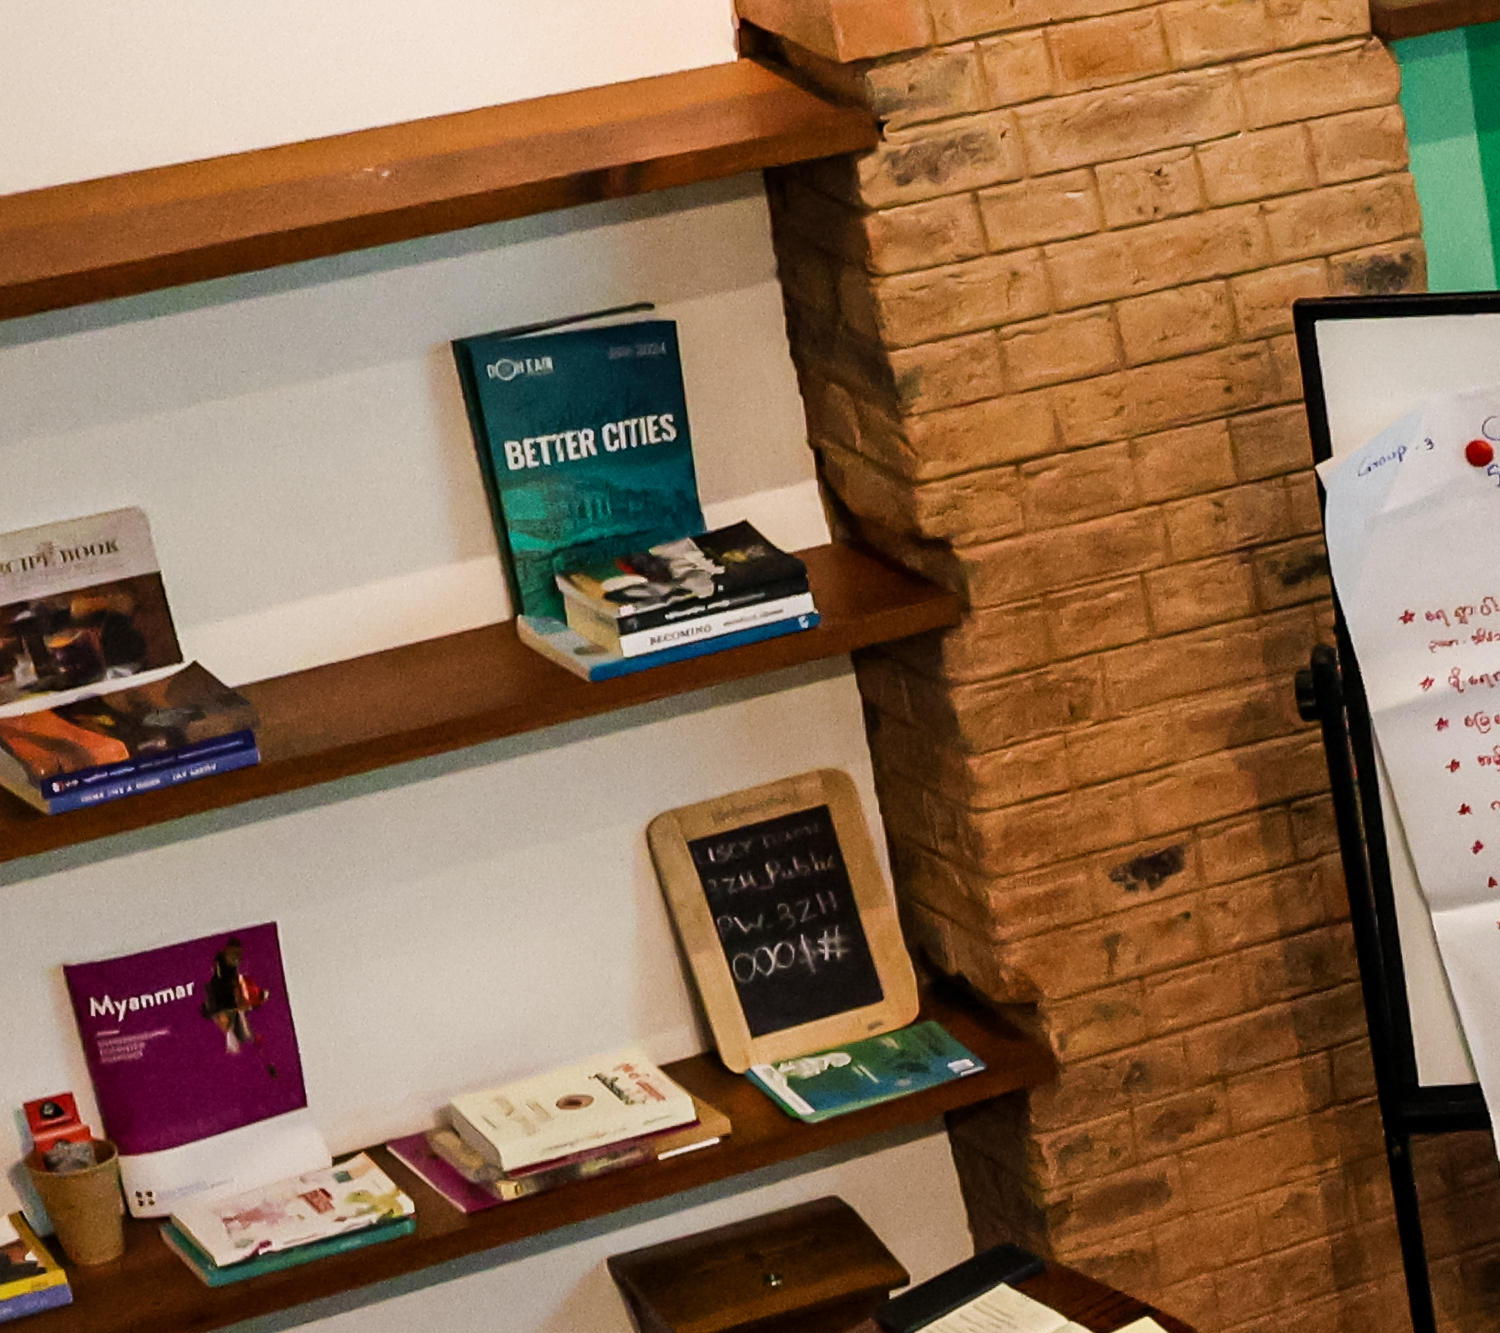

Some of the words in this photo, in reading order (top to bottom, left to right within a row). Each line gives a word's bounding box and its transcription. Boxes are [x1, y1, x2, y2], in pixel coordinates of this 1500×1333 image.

[503, 427, 599, 471] BETTER
[600, 412, 679, 453] CITIES
[650, 624, 713, 646] BECOMING
[90, 981, 195, 1022] Myanmar
